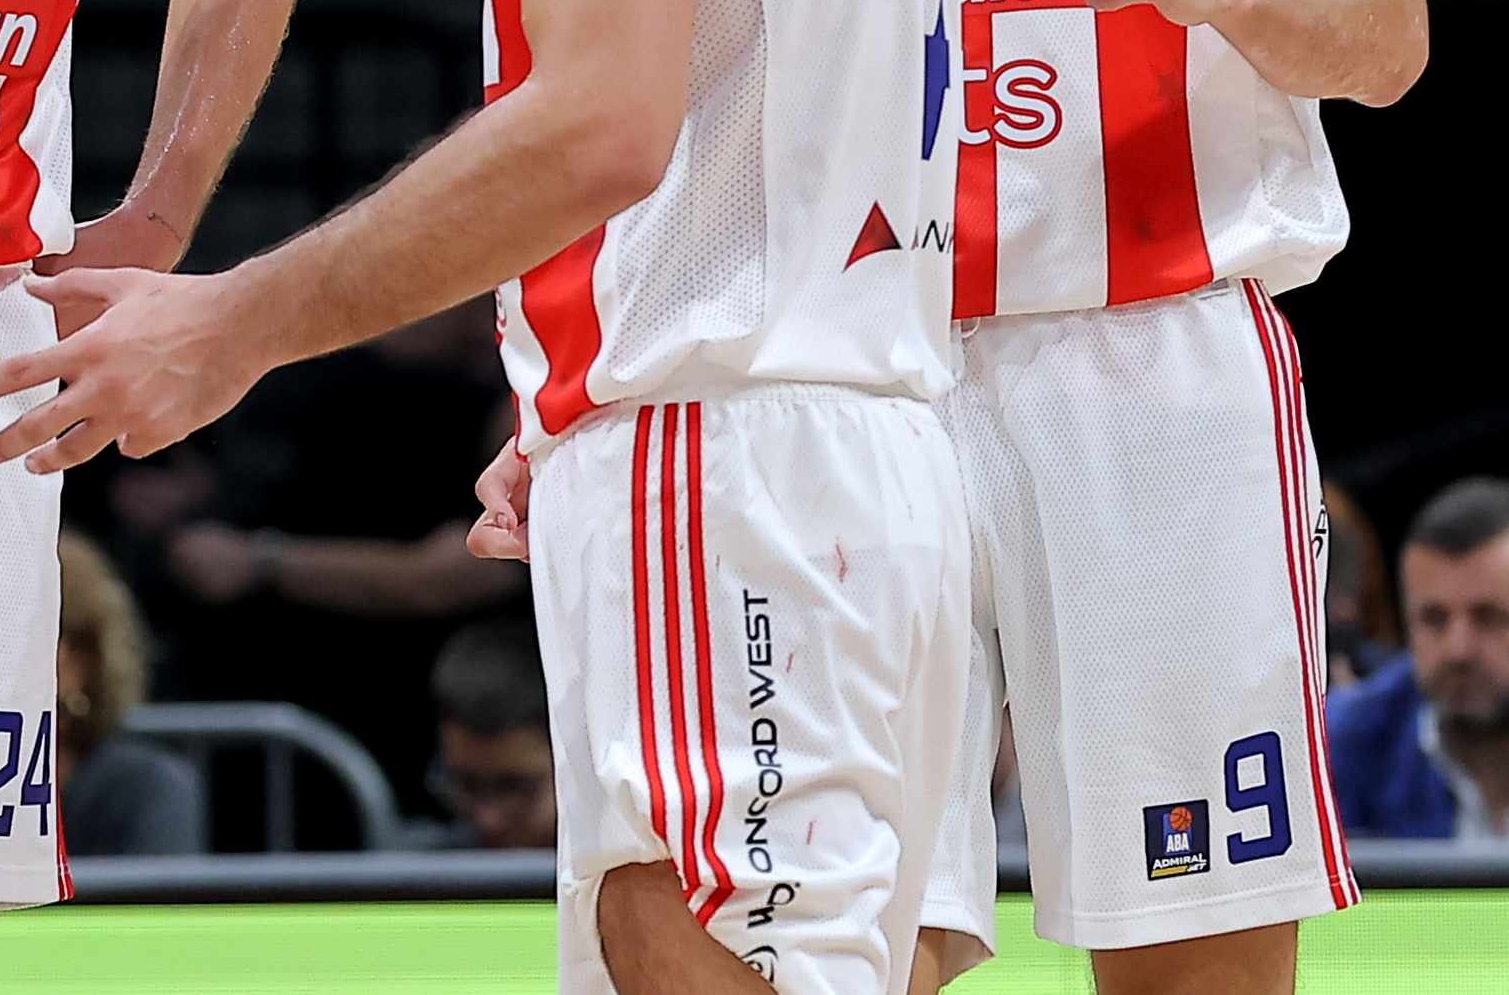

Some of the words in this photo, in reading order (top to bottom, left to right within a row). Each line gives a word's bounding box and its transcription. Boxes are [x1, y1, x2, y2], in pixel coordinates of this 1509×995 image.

[957, 50, 1063, 150] ts
[742, 588, 777, 709] WEST
[743, 716, 784, 873] ONCORD
[1166, 833, 1189, 852] ABA
[1224, 731, 1292, 865] 9
[1153, 853, 1207, 869] ADMIRAL
